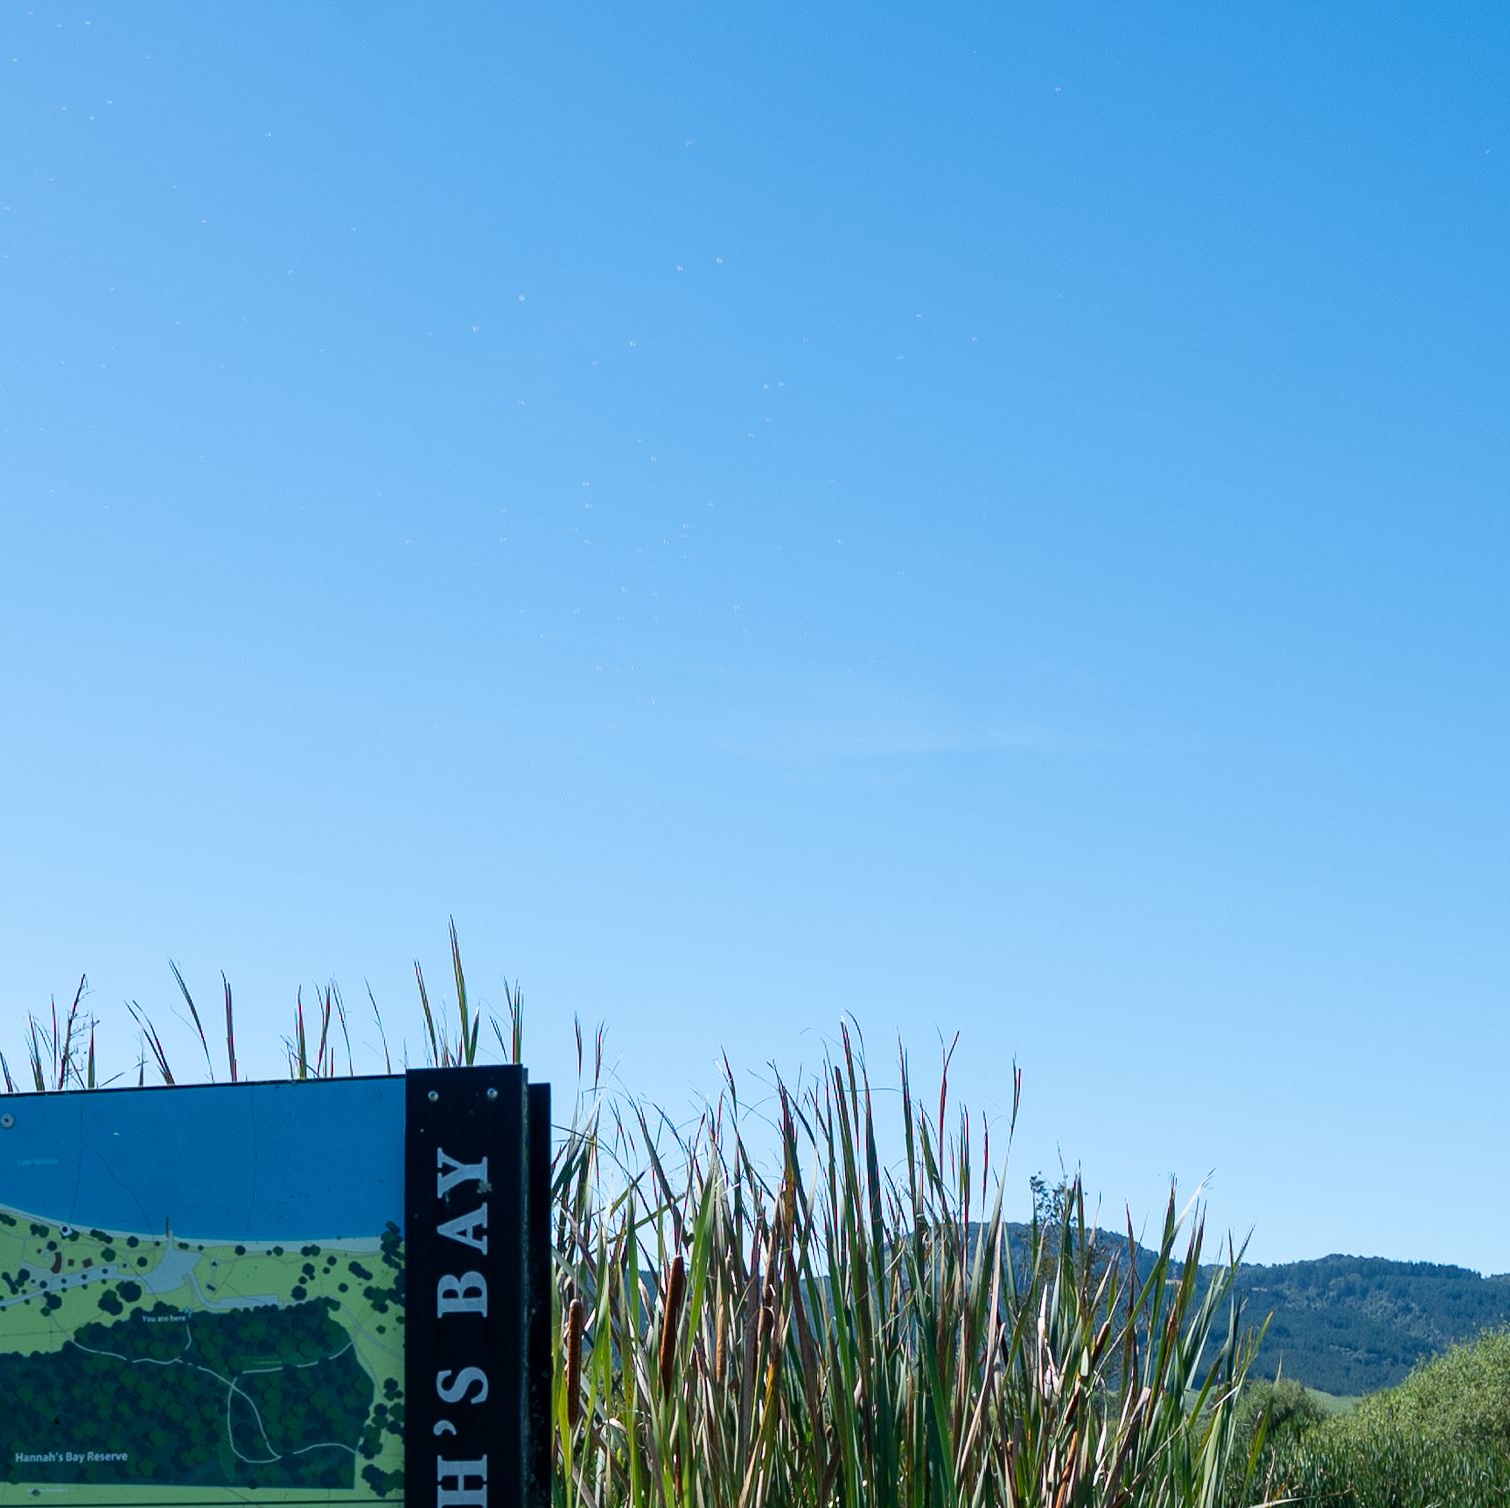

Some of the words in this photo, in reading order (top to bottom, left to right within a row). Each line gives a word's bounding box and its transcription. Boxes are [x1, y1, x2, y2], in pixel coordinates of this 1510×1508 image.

[436, 1146, 489, 1319] BAY
[14, 1452, 63, 1461] Hannah's
[65, 1451, 85, 1463] Bay
[86, 1451, 128, 1461] Reserve
